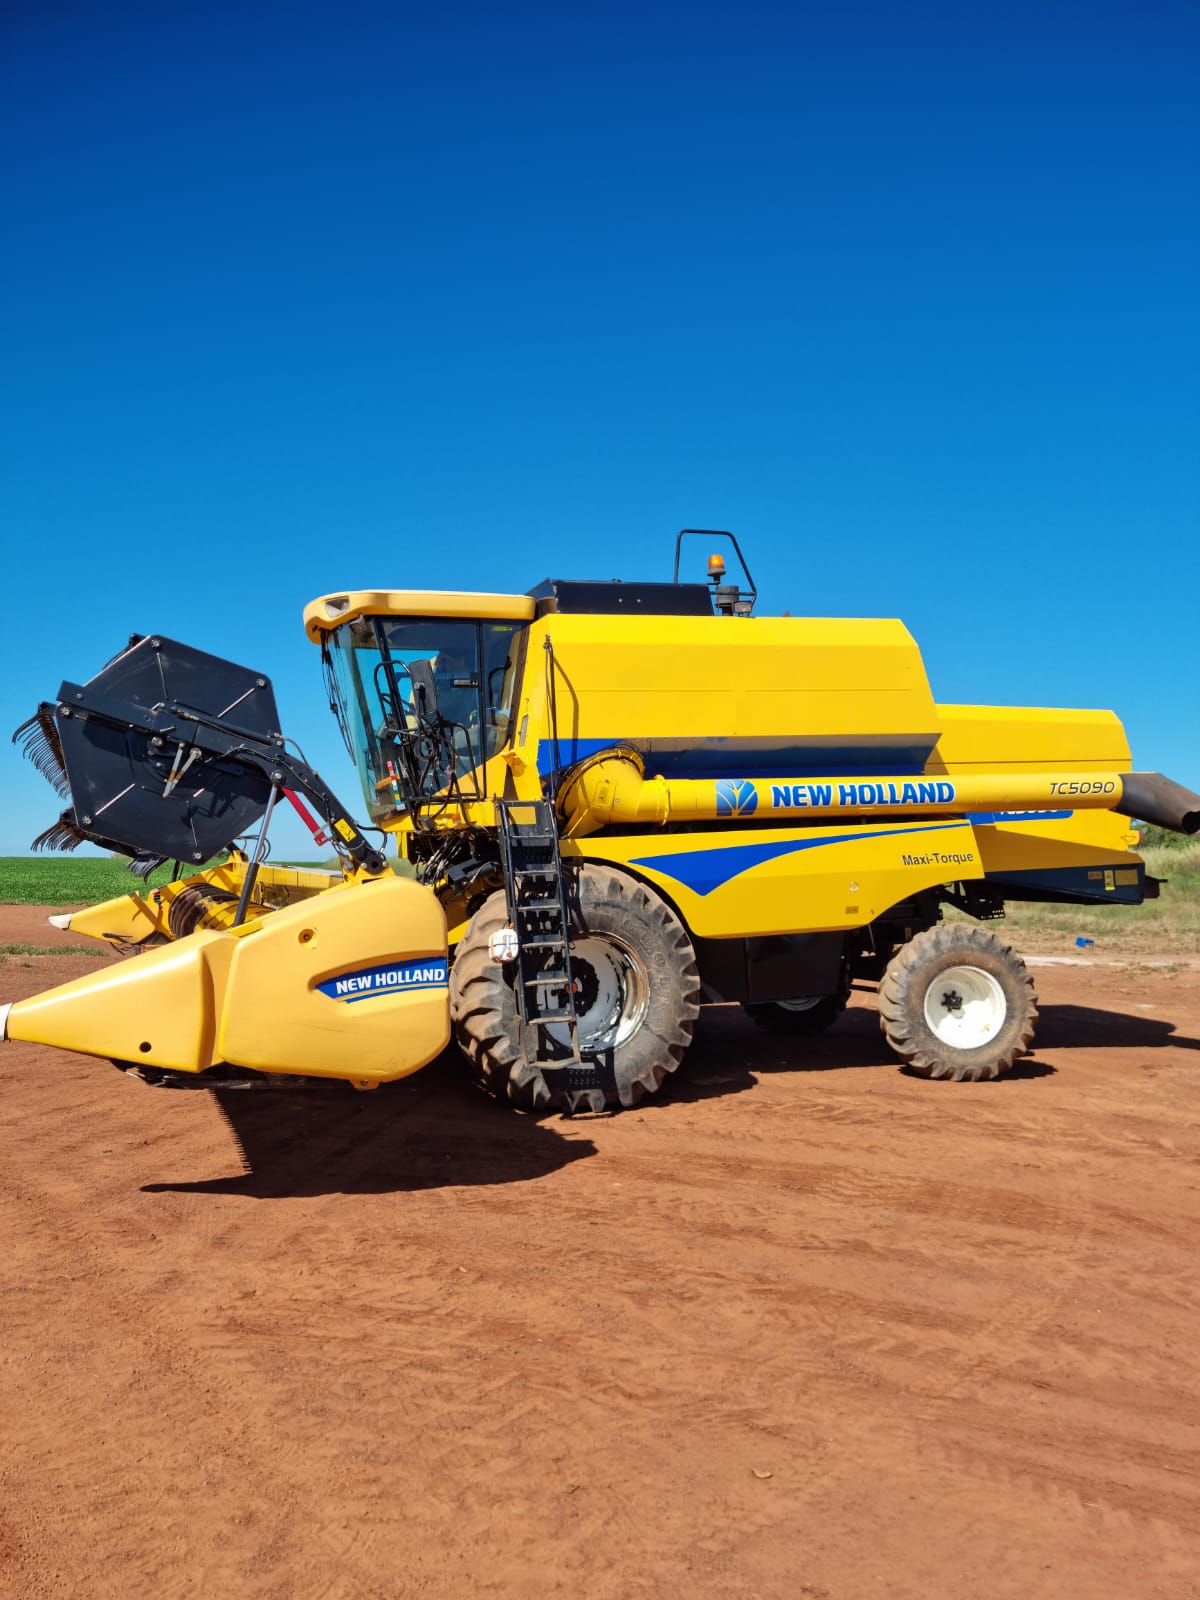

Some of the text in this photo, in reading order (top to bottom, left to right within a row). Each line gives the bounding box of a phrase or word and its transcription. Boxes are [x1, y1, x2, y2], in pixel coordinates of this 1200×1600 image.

[771, 781, 955, 808] NEW HOLLAND
[1050, 781, 1115, 795] TC5090
[902, 852, 973, 866] Maxi-Torque
[336, 968, 445, 995] NEW HOLLAND
